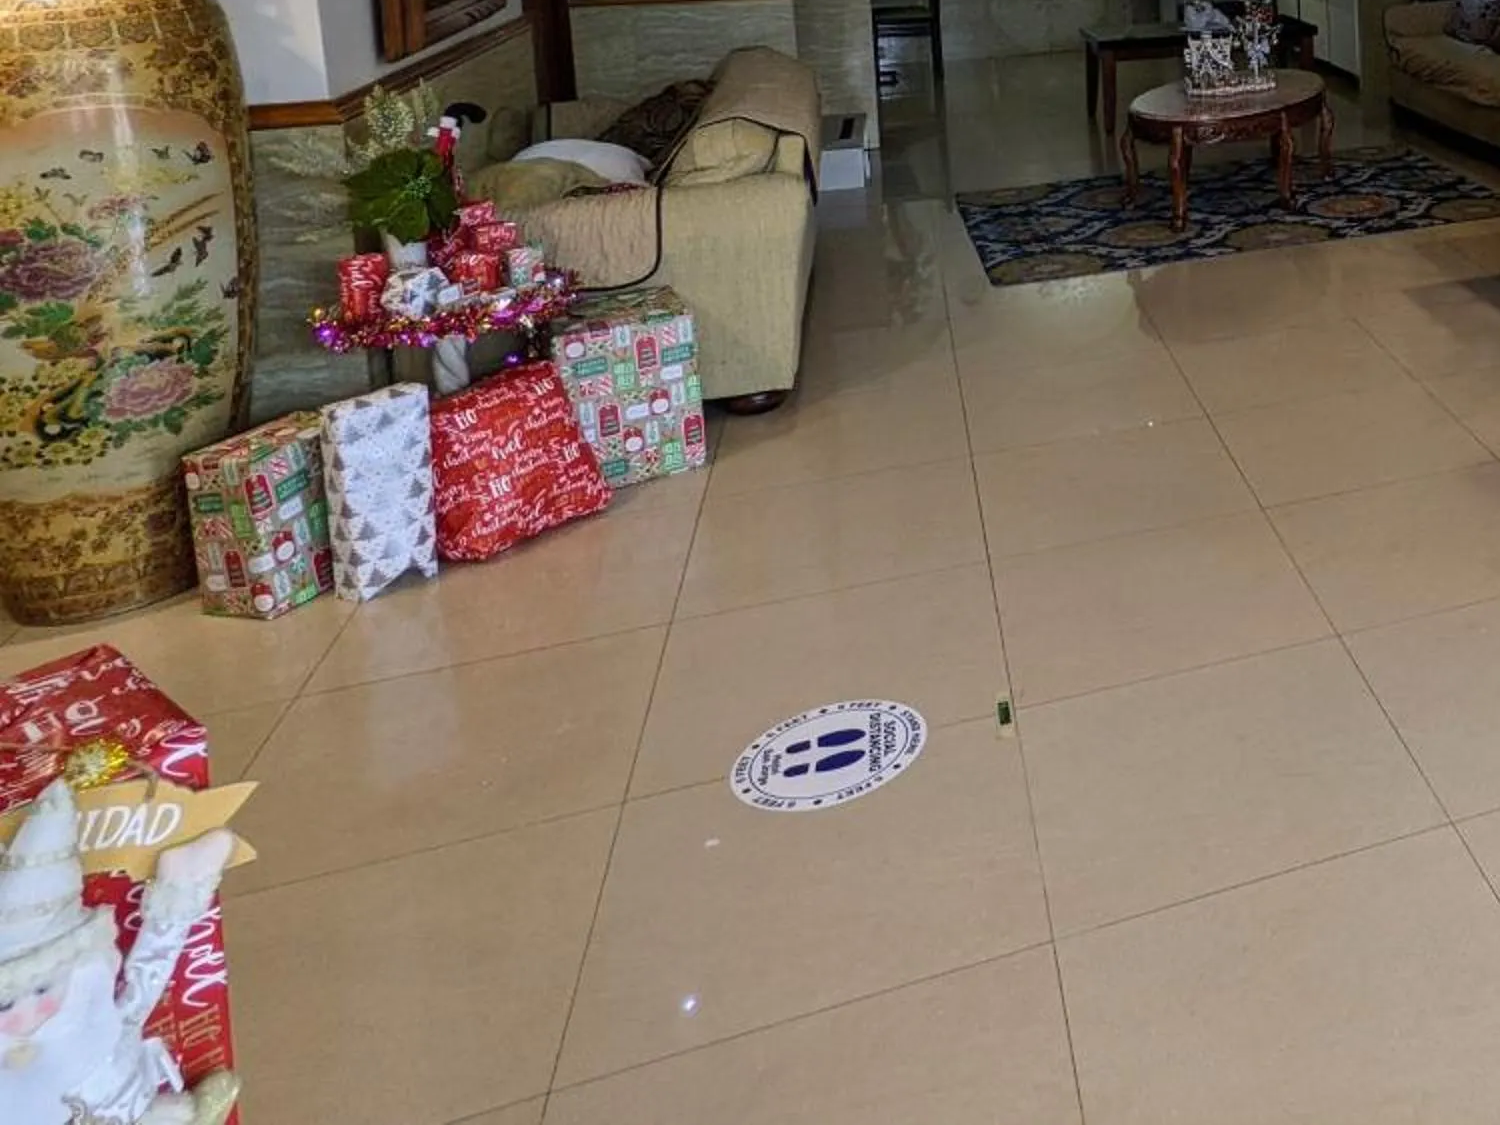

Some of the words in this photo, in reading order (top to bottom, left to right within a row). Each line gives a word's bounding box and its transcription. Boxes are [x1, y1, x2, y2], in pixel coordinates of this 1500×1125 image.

[869, 712, 882, 773] DISTANCING
[884, 720, 898, 757] SOCIAL
[77, 802, 182, 853] IDAD
